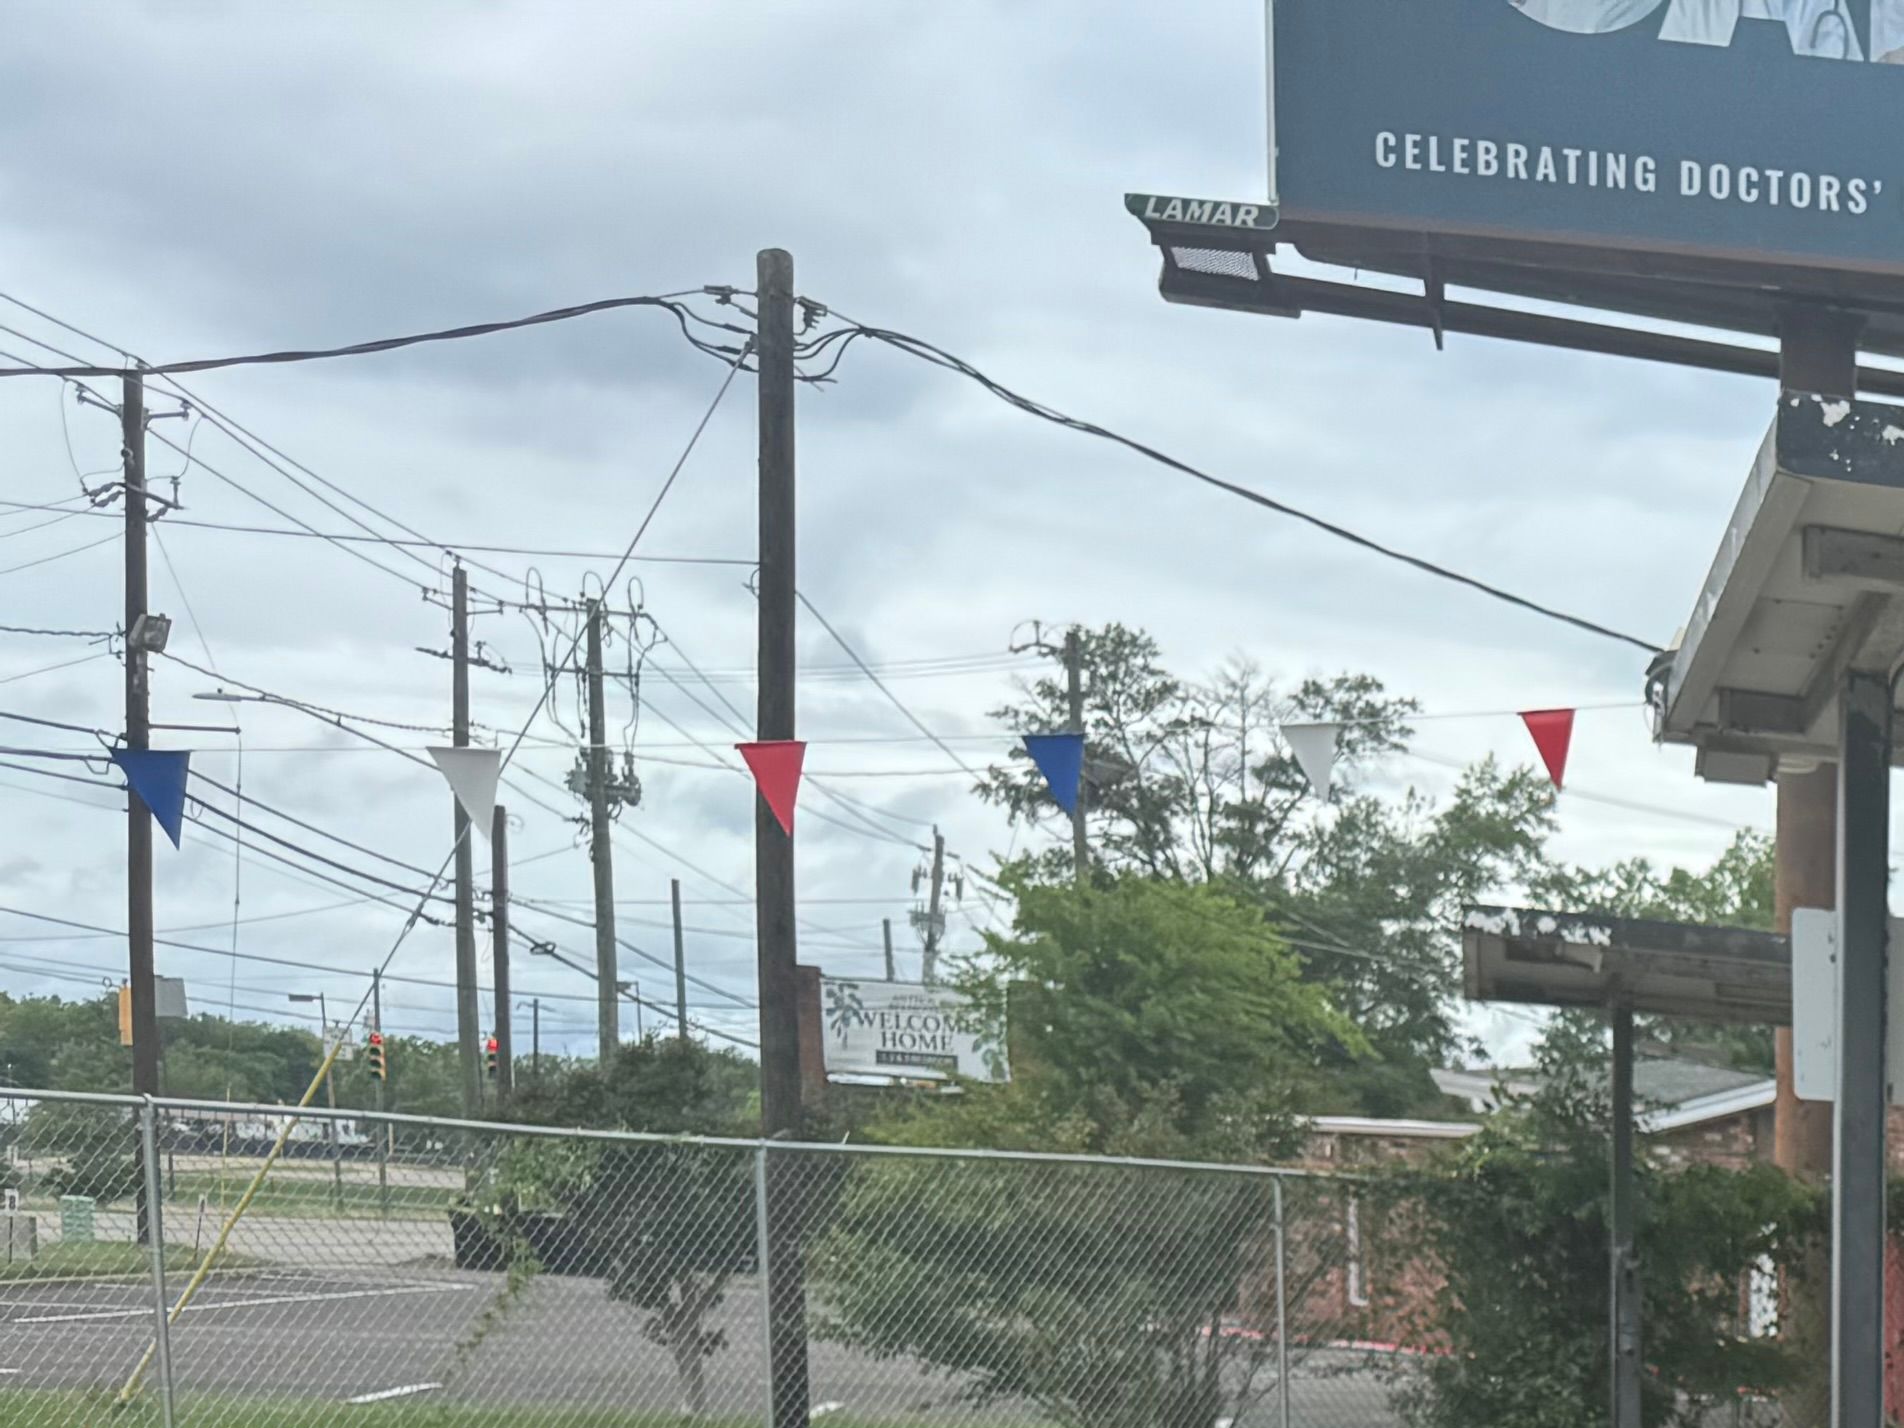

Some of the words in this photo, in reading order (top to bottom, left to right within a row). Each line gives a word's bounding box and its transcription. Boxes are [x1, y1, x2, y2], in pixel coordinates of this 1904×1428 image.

[1374, 131, 1658, 192] CELEBRATING
[1680, 159, 1884, 214] DOCTORS'
[1143, 195, 1260, 228] LAMAR
[881, 1031, 954, 1052] HOME
